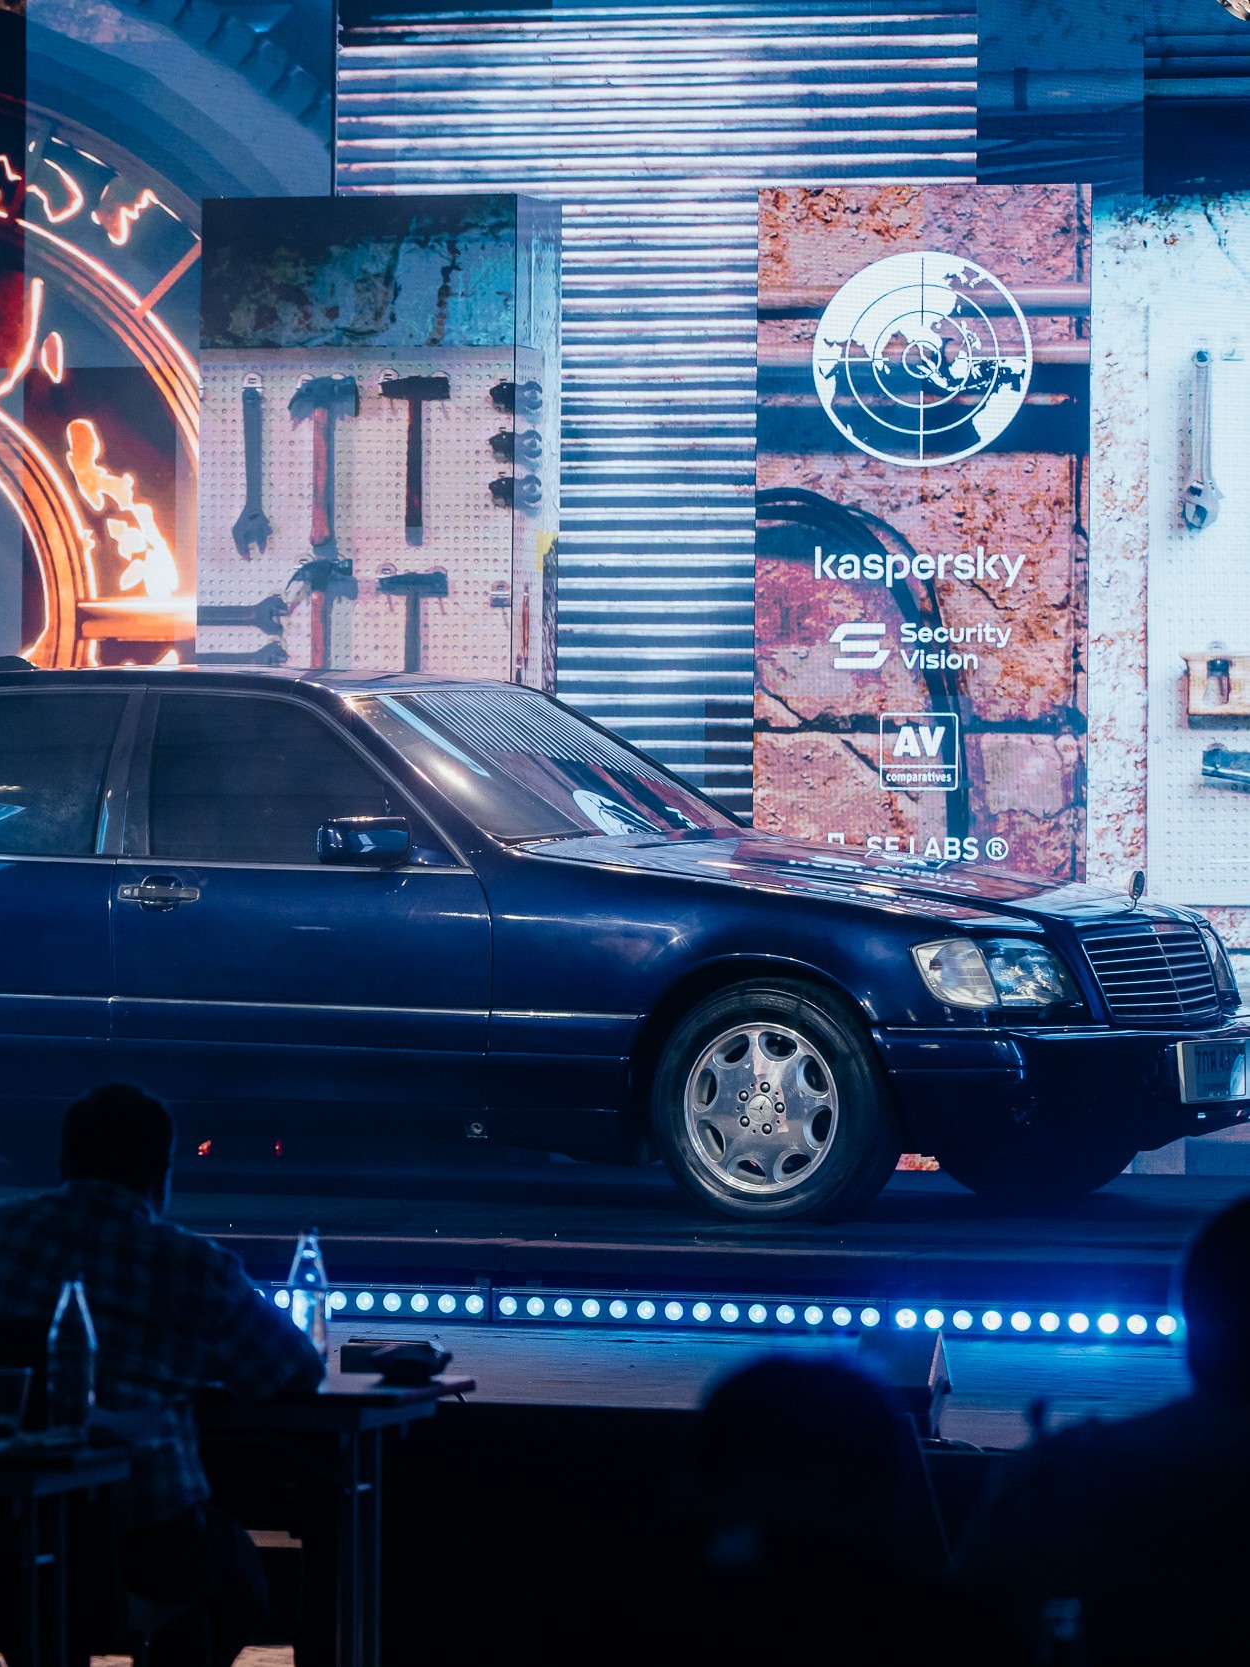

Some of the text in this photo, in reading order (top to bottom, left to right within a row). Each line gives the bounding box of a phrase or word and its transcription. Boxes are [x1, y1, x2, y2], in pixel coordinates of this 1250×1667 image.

[814, 545, 1026, 588] kaspersky
[900, 622, 1013, 649] Security
[900, 648, 979, 671] Vision
[892, 726, 946, 757] AV
[885, 771, 952, 784] comparatives
